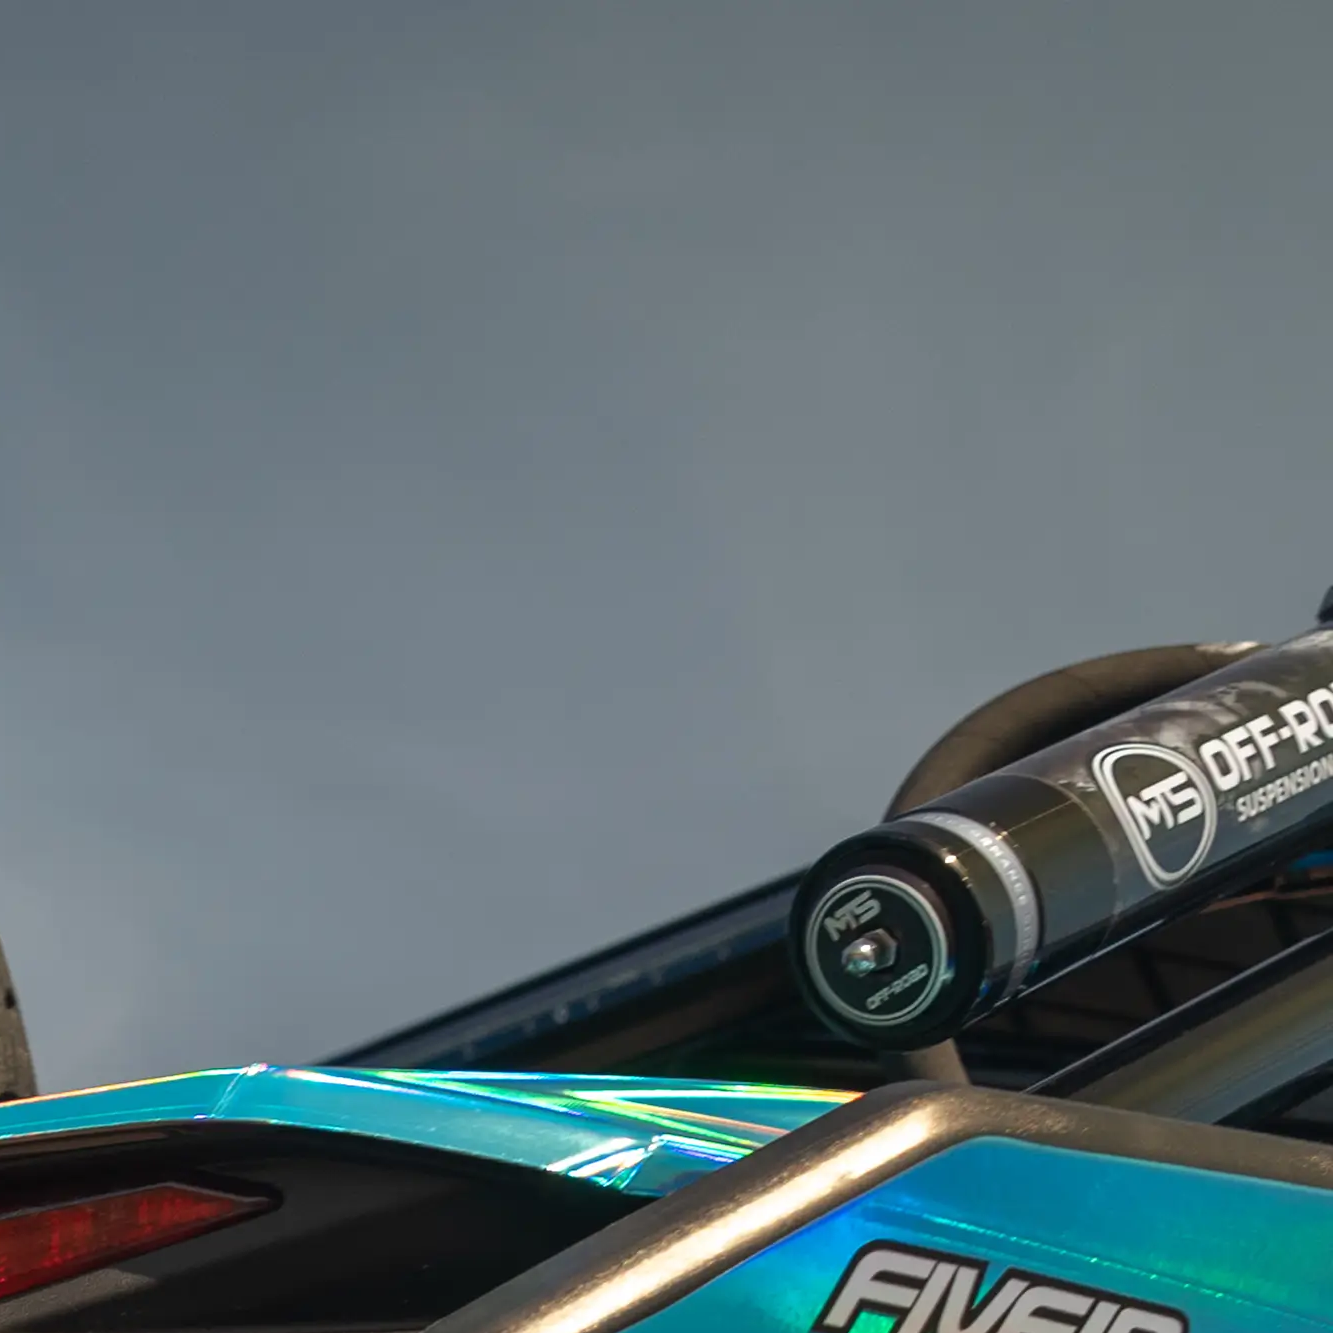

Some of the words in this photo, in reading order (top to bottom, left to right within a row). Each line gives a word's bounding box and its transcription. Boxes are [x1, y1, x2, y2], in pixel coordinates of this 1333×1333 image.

[1199, 681, 1333, 792] OFF-RO
[1127, 772, 1204, 842] MTS
[823, 889, 881, 942] MTS
